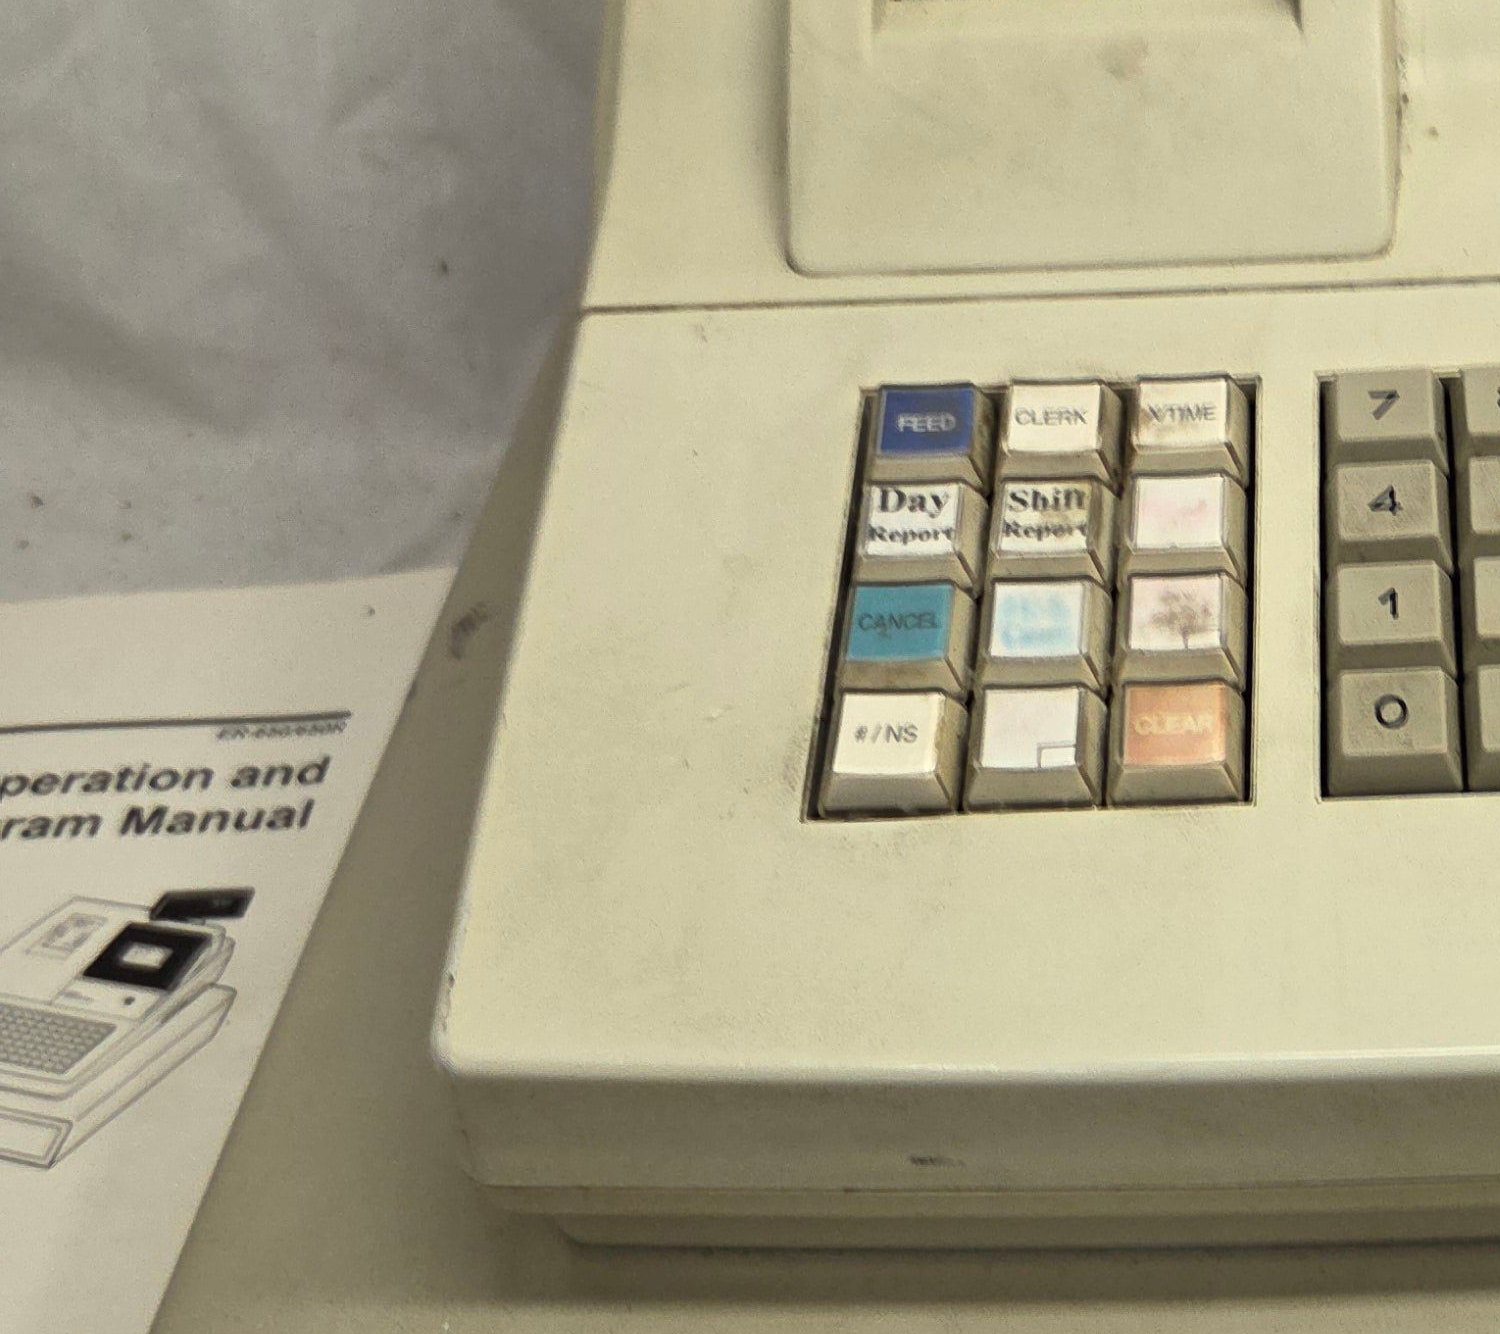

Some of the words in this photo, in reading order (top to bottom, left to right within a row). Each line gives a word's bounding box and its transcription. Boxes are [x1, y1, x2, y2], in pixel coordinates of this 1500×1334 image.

[1014, 406, 1088, 427] CLERK
[1367, 389, 1401, 421] 7
[896, 411, 956, 433] FEED
[877, 485, 950, 519] Day
[1367, 484, 1402, 516] 4
[867, 522, 955, 545] Report
[1002, 520, 1088, 543] Report
[1377, 586, 1400, 620] 1
[858, 611, 943, 633] CANCEL
[853, 723, 919, 746] #/NS
[230, 753, 332, 789] and
[117, 798, 316, 837] Manual
